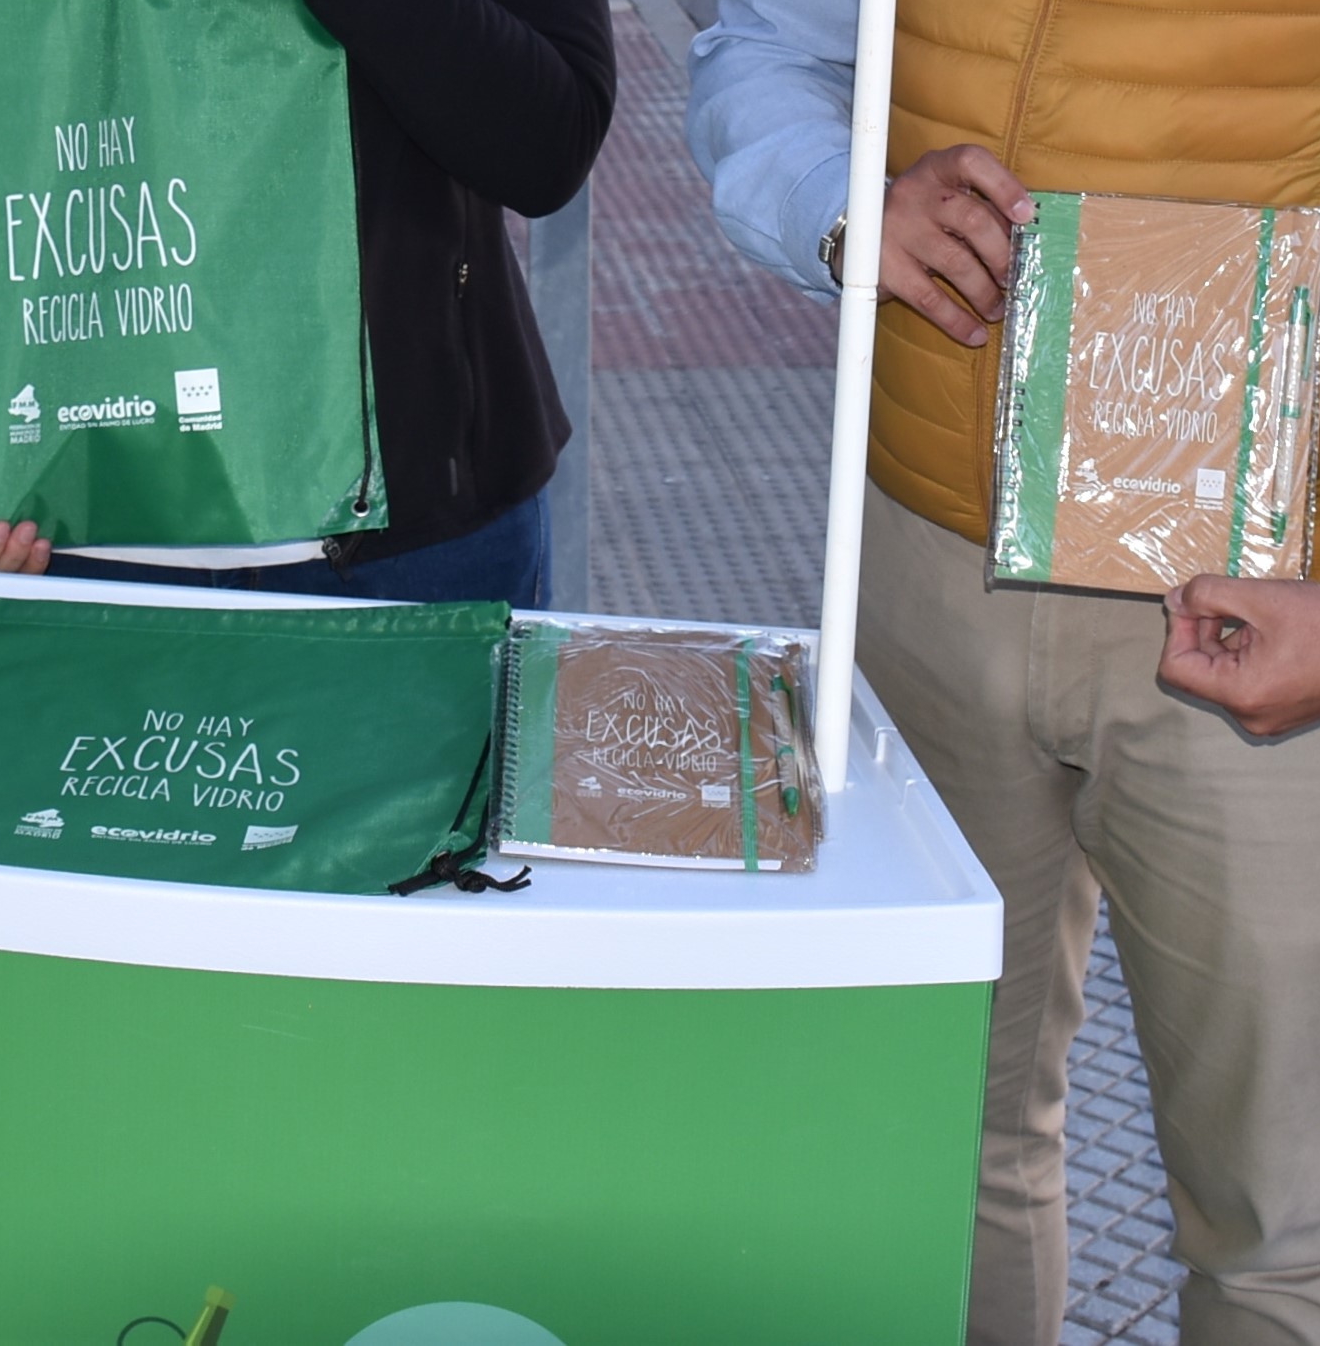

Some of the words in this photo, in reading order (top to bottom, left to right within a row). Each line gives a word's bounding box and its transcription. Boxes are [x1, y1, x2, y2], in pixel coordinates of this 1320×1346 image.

[55, 122, 89, 172] NO
[99, 115, 136, 168] HAY
[5, 177, 197, 282] EXCUSAS
[22, 291, 104, 346] RECICLA
[114, 283, 194, 337] VIDRIO
[1133, 291, 1158, 324] NO
[1165, 294, 1198, 328] HAY
[1089, 331, 1228, 401] EXCUSAS
[57, 394, 156, 423] ecovidrio
[192, 422, 223, 432] Madrid
[1093, 400, 1155, 438] RECICLA
[1166, 408, 1218, 444] VIDRIO
[1113, 476, 1181, 494] ecovidrio
[623, 693, 646, 711] NO
[143, 709, 184, 732] NO
[196, 716, 254, 738] HAY
[586, 710, 722, 751] EXCUSAS
[60, 735, 301, 786] EXCUSAS
[61, 775, 171, 802] RECICLA
[192, 783, 285, 812] VIDRIO
[91, 825, 217, 843] ecovidrio
